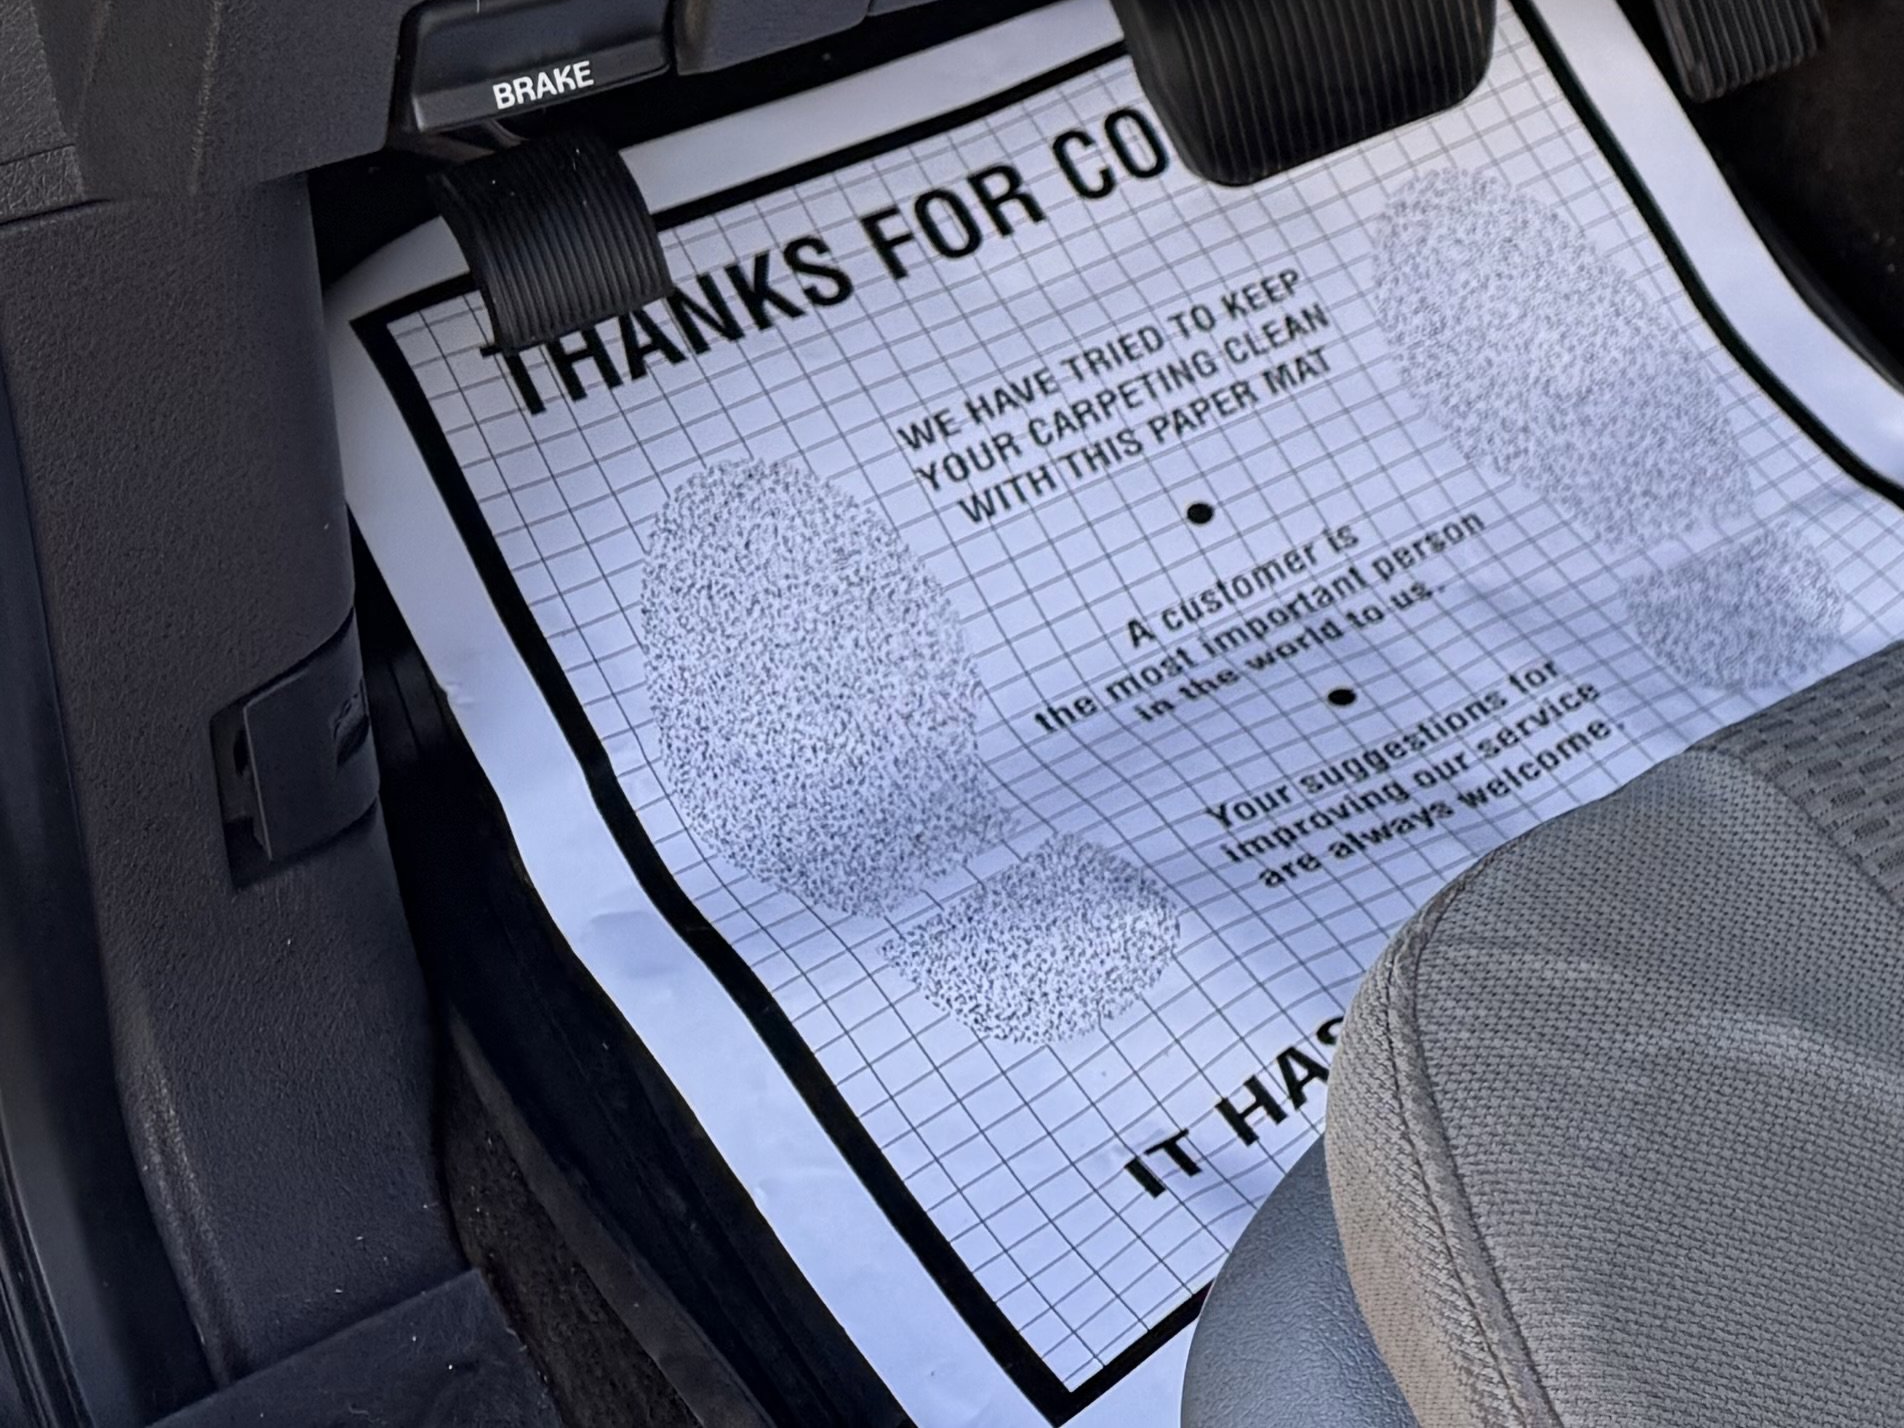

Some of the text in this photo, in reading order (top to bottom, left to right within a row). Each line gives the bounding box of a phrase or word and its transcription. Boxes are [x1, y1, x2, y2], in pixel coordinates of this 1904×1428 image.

[491, 60, 595, 111] BRAKE
[479, 235, 854, 415] THANKS
[859, 162, 1046, 280] FOR
[898, 267, 1301, 451] WE HAVE TRIED TO KEEP
[916, 302, 1330, 492] YOUR CARPETING CLEAN
[957, 346, 1331, 525] WITH THIS PAPER MAT
[1033, 511, 1485, 734] the most important person
[1125, 522, 1360, 648] A customer is
[1134, 577, 1447, 723] in the world to us.
[1206, 658, 1560, 828] Your suggestions for
[1220, 681, 1601, 864] improving our service
[1258, 717, 1627, 888] are always welcome.
[1124, 1128, 1202, 1198] IT
